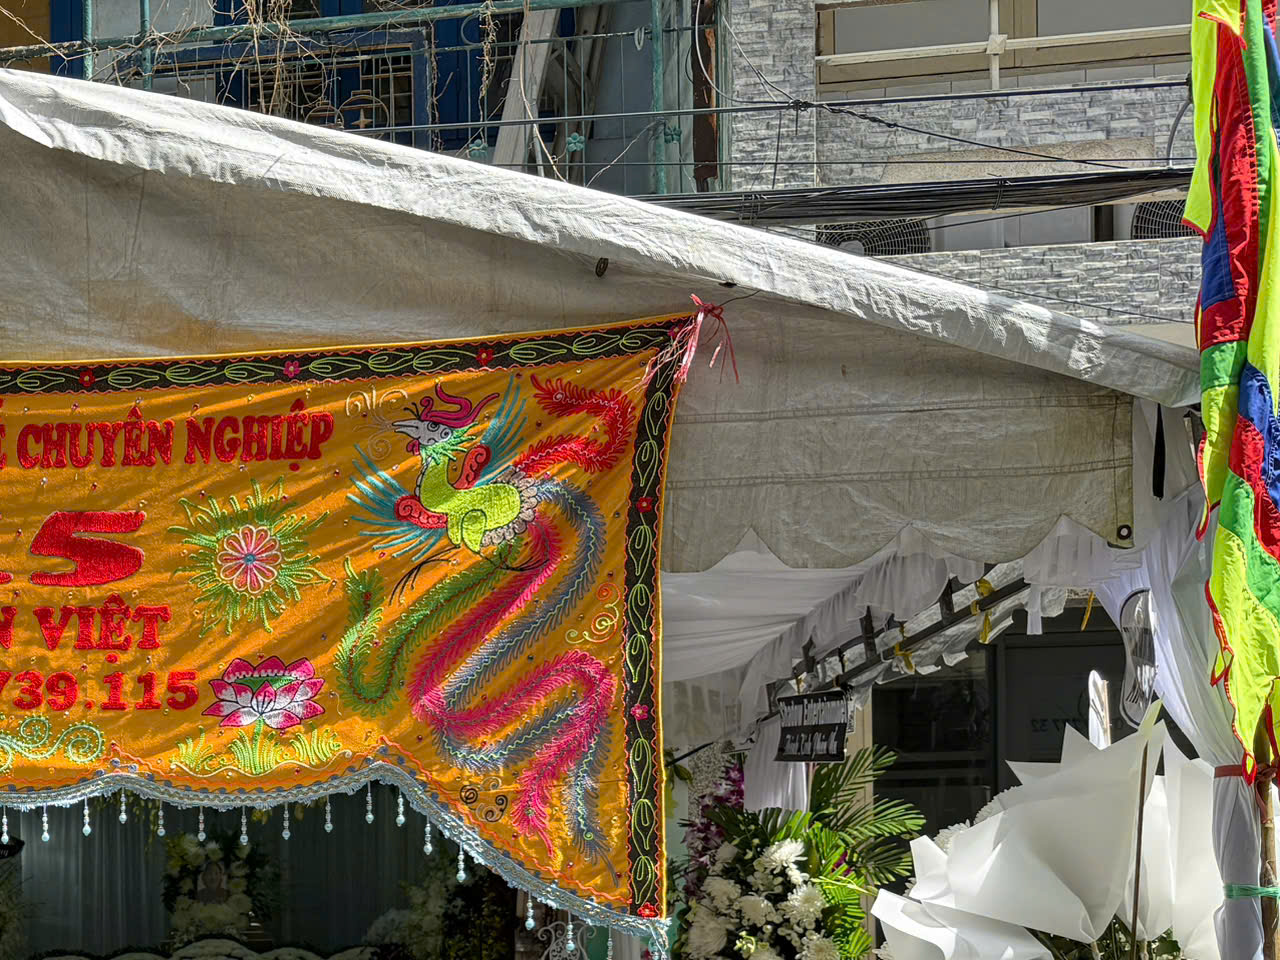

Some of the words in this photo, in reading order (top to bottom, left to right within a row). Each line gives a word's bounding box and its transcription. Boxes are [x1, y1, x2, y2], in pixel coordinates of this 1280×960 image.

[16, 406, 175, 470] CHUYÊN
[183, 399, 336, 472] NGHIỆP
[33, 596, 172, 664] VIỆT
